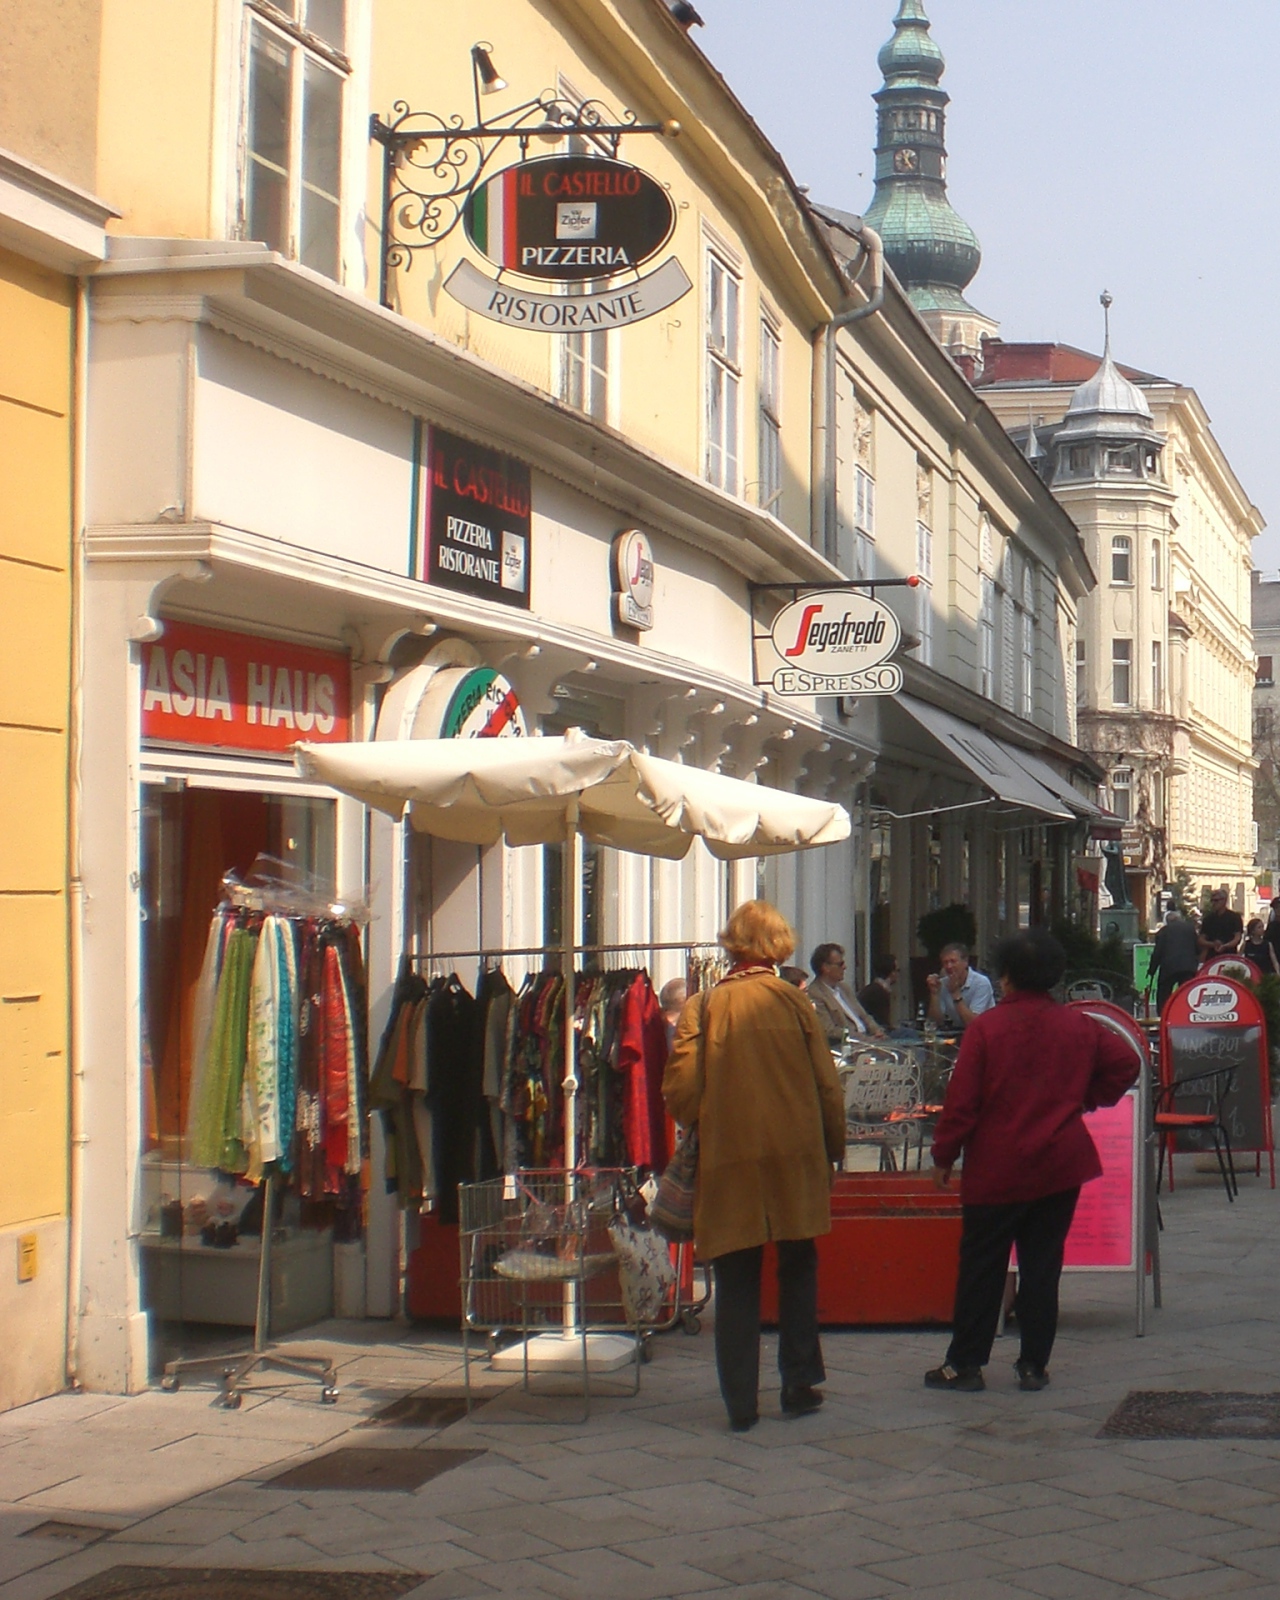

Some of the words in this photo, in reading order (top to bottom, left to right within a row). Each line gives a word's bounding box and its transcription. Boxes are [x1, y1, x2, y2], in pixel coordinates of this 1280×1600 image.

[520, 174, 535, 196] IL
[543, 171, 641, 196] CASTELLO
[522, 246, 629, 265] PIZZERIA
[488, 291, 646, 326] RISTORANTE
[434, 452, 448, 490] IL
[453, 458, 529, 518] CASTELLO
[446, 515, 493, 551] PIZZERIA
[439, 544, 500, 584] RISTORANTE
[785, 604, 886, 657] Segafredo
[831, 645, 868, 654] ZANETTI
[144, 645, 233, 723] ASIA
[246, 662, 336, 735] HAUS
[780, 669, 896, 692] ESPRESSO
